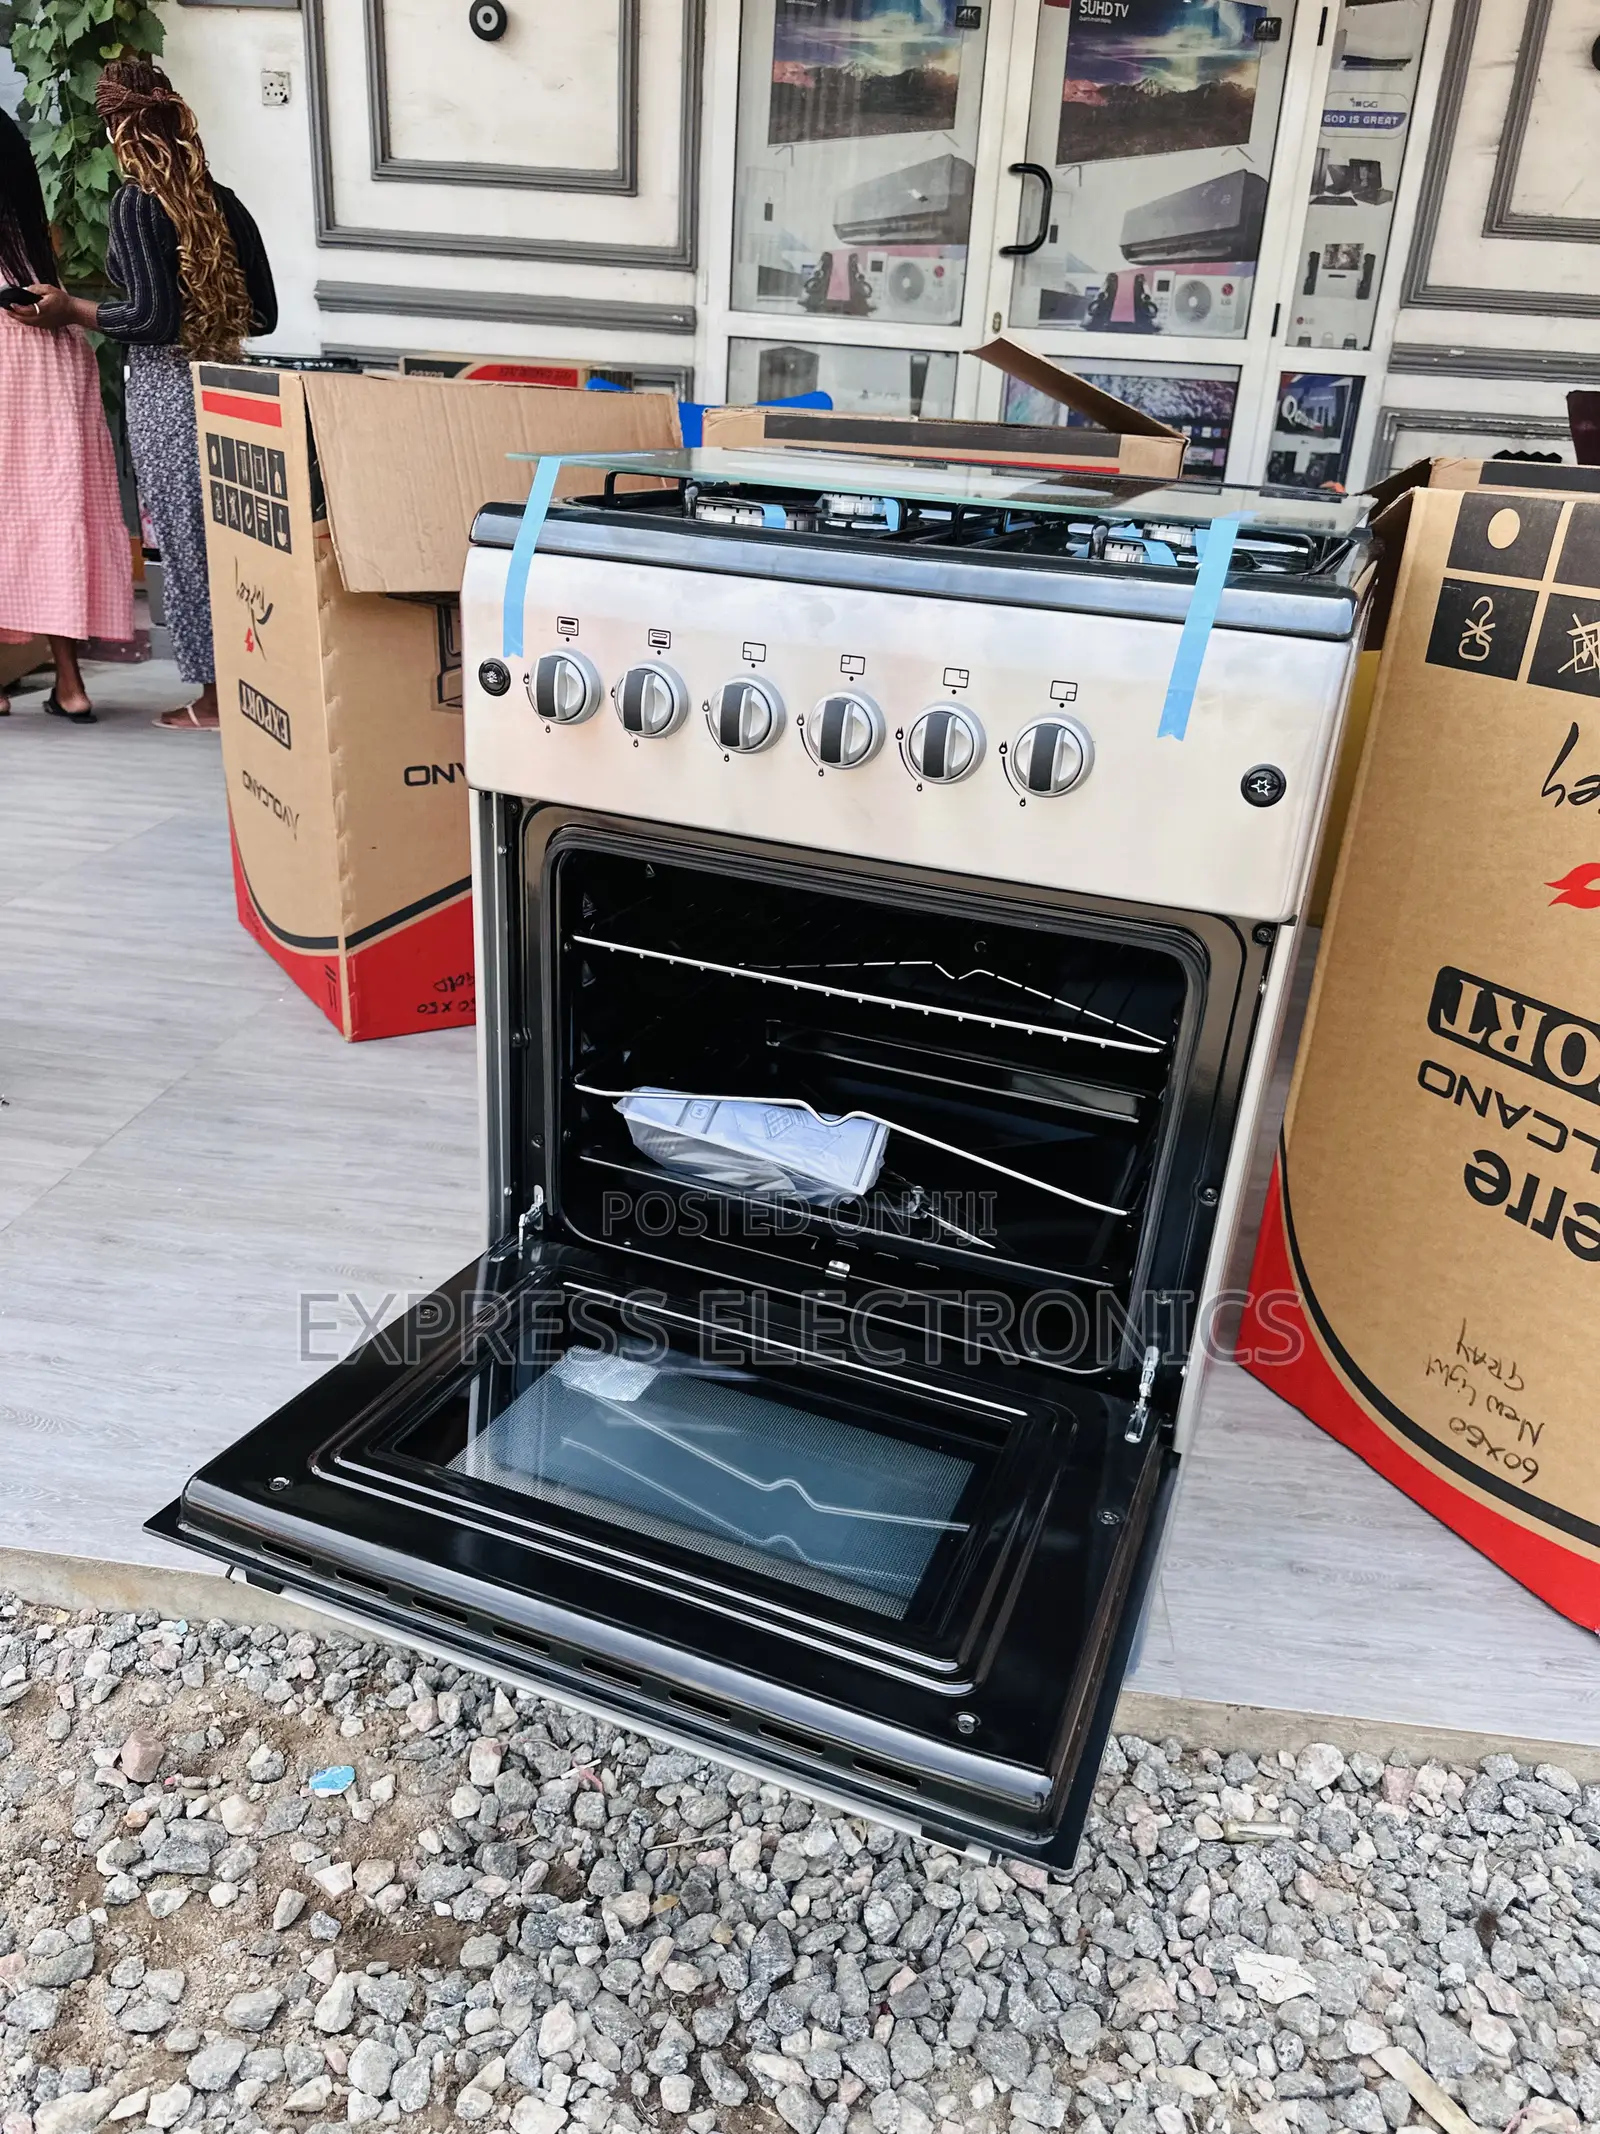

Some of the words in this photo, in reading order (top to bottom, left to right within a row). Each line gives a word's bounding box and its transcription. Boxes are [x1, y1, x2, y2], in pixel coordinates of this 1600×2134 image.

[958, 9, 978, 21] 4K
[1079, 0, 1112, 16] SUHD
[1259, 20, 1277, 31] 4K
[1324, 114, 1346, 123] GOD
[1349, 115, 1360, 124] IS
[1363, 115, 1399, 125] GREAT
[241, 683, 289, 745] EXPORT
[242, 769, 299, 841] VOLCANO
[1440, 979, 1600, 1090] ORT
[1418, 1059, 1600, 1175] LCANO
[1464, 1149, 1600, 1263] erre
